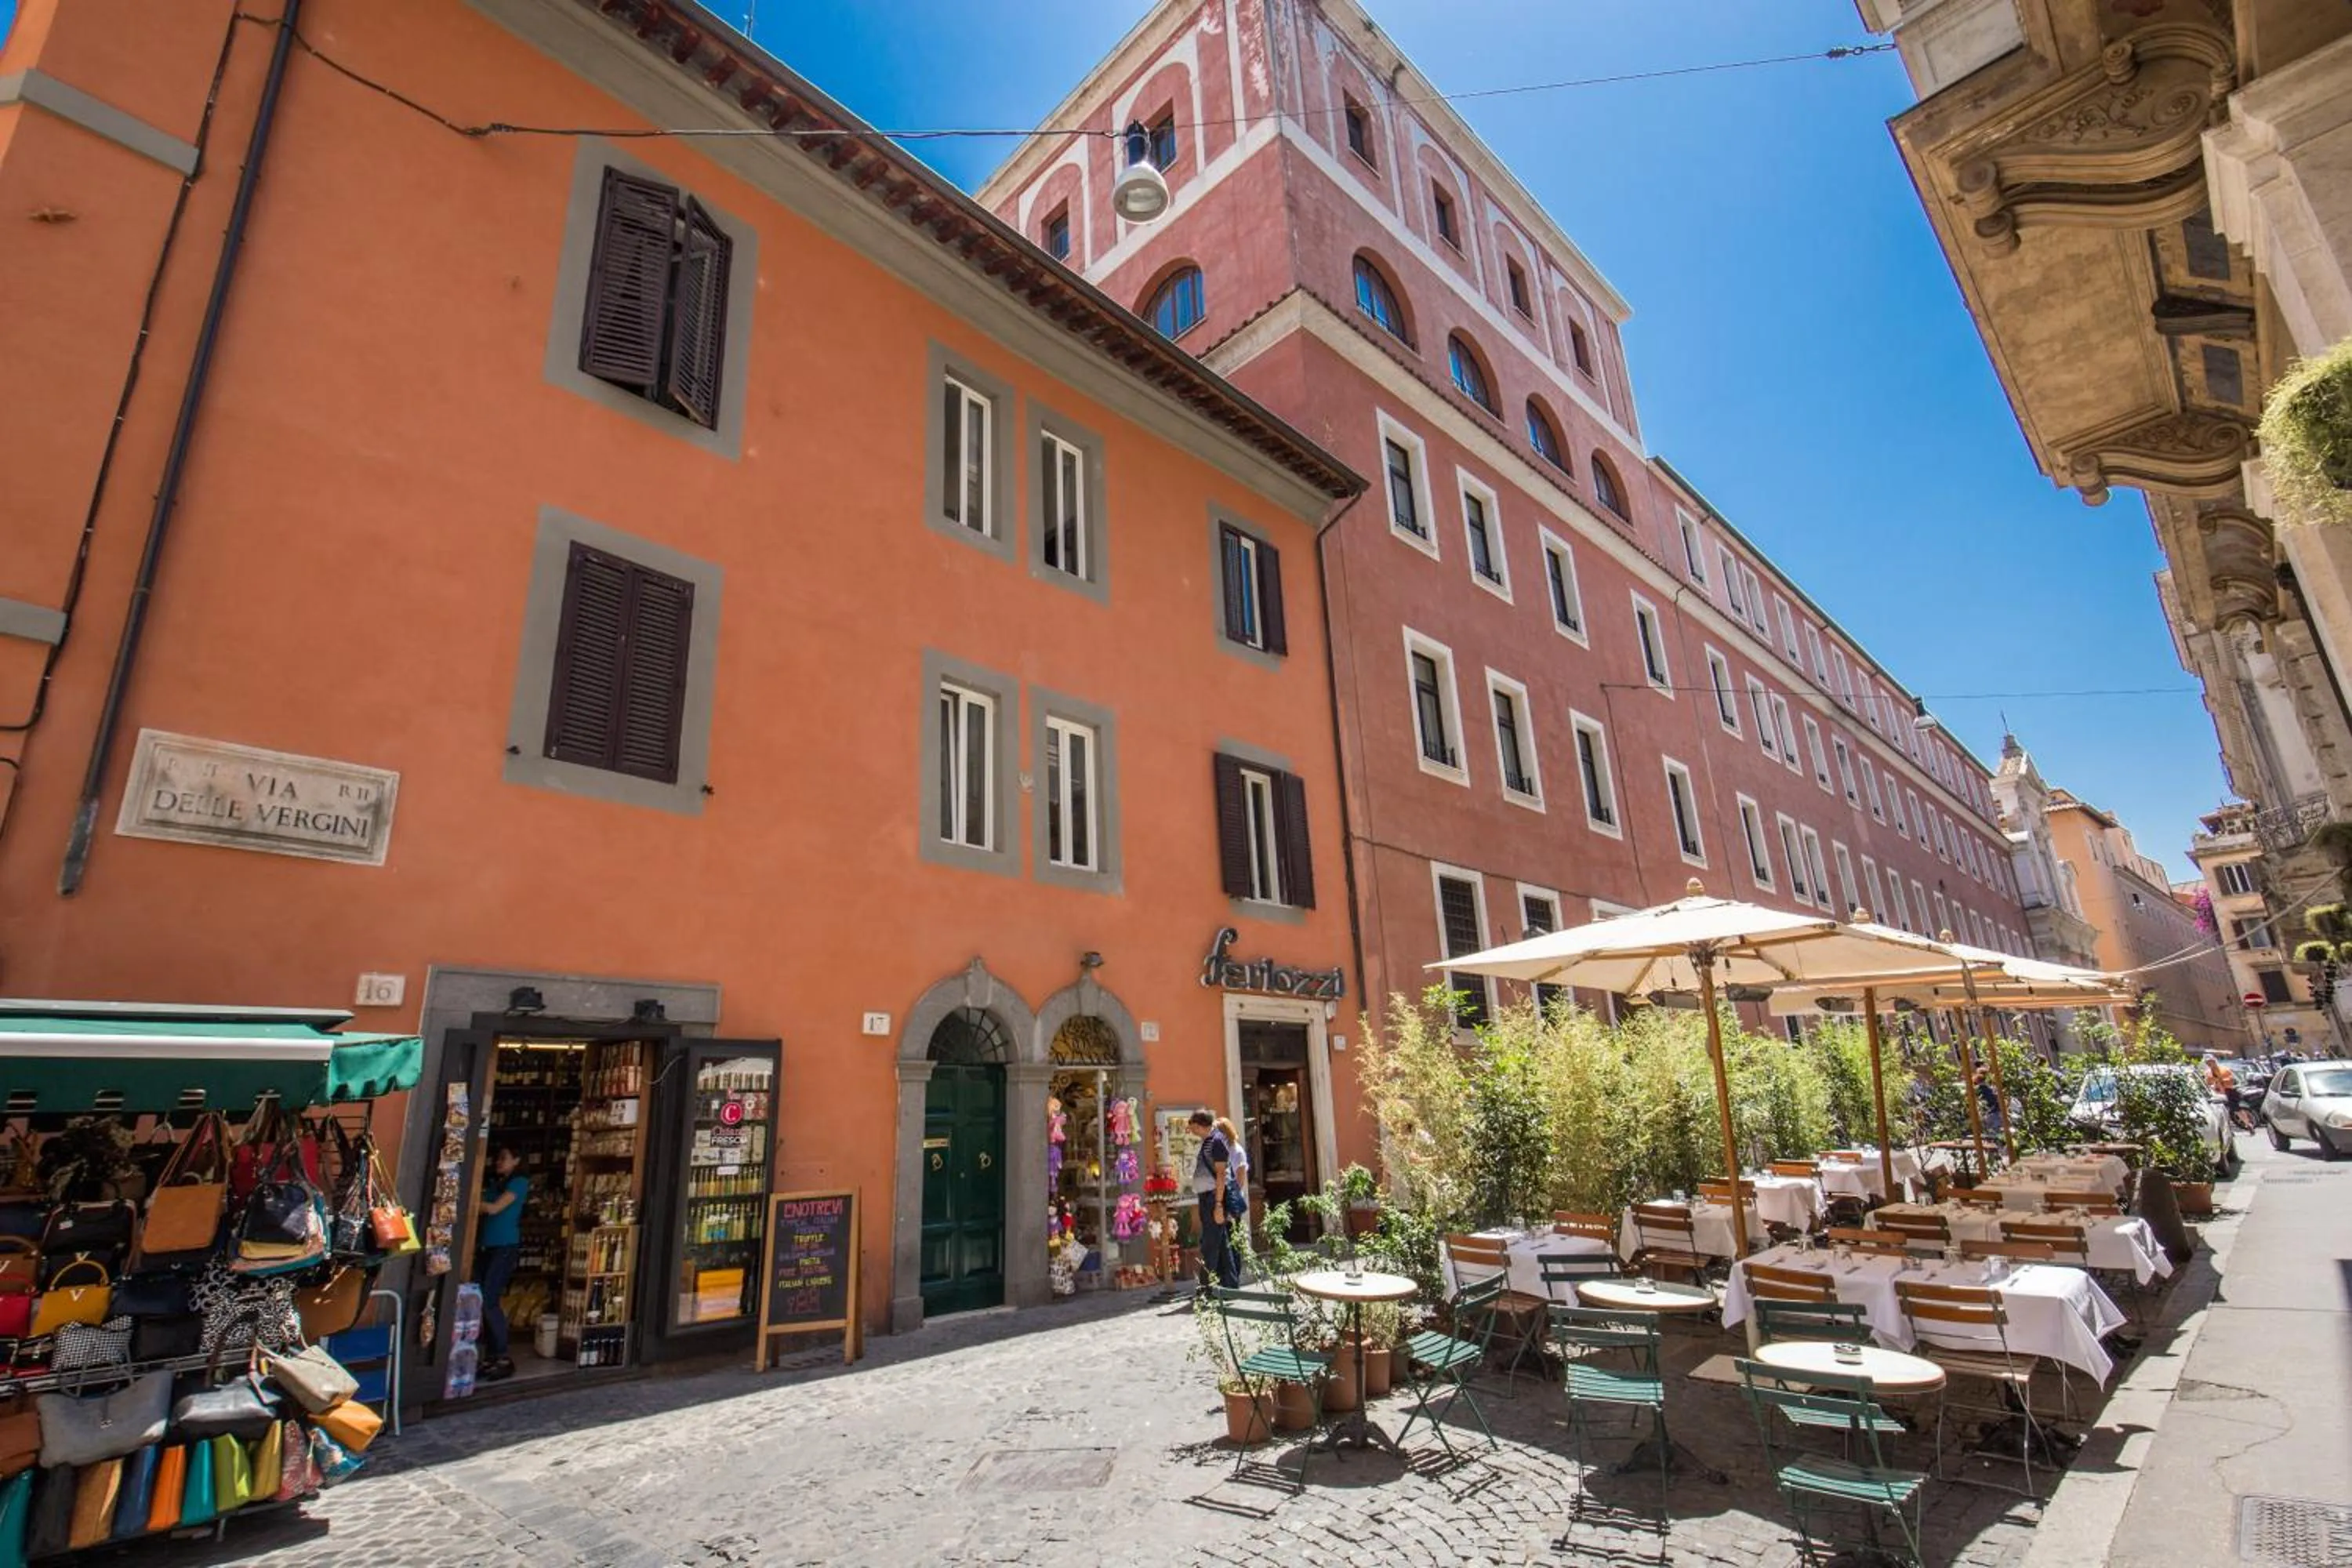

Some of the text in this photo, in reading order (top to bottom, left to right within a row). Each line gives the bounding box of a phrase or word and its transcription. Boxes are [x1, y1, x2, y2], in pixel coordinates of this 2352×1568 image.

[247, 772, 299, 800] VIA
[153, 789, 368, 839] DELLE VERGINI
[365, 978, 395, 1000] 16
